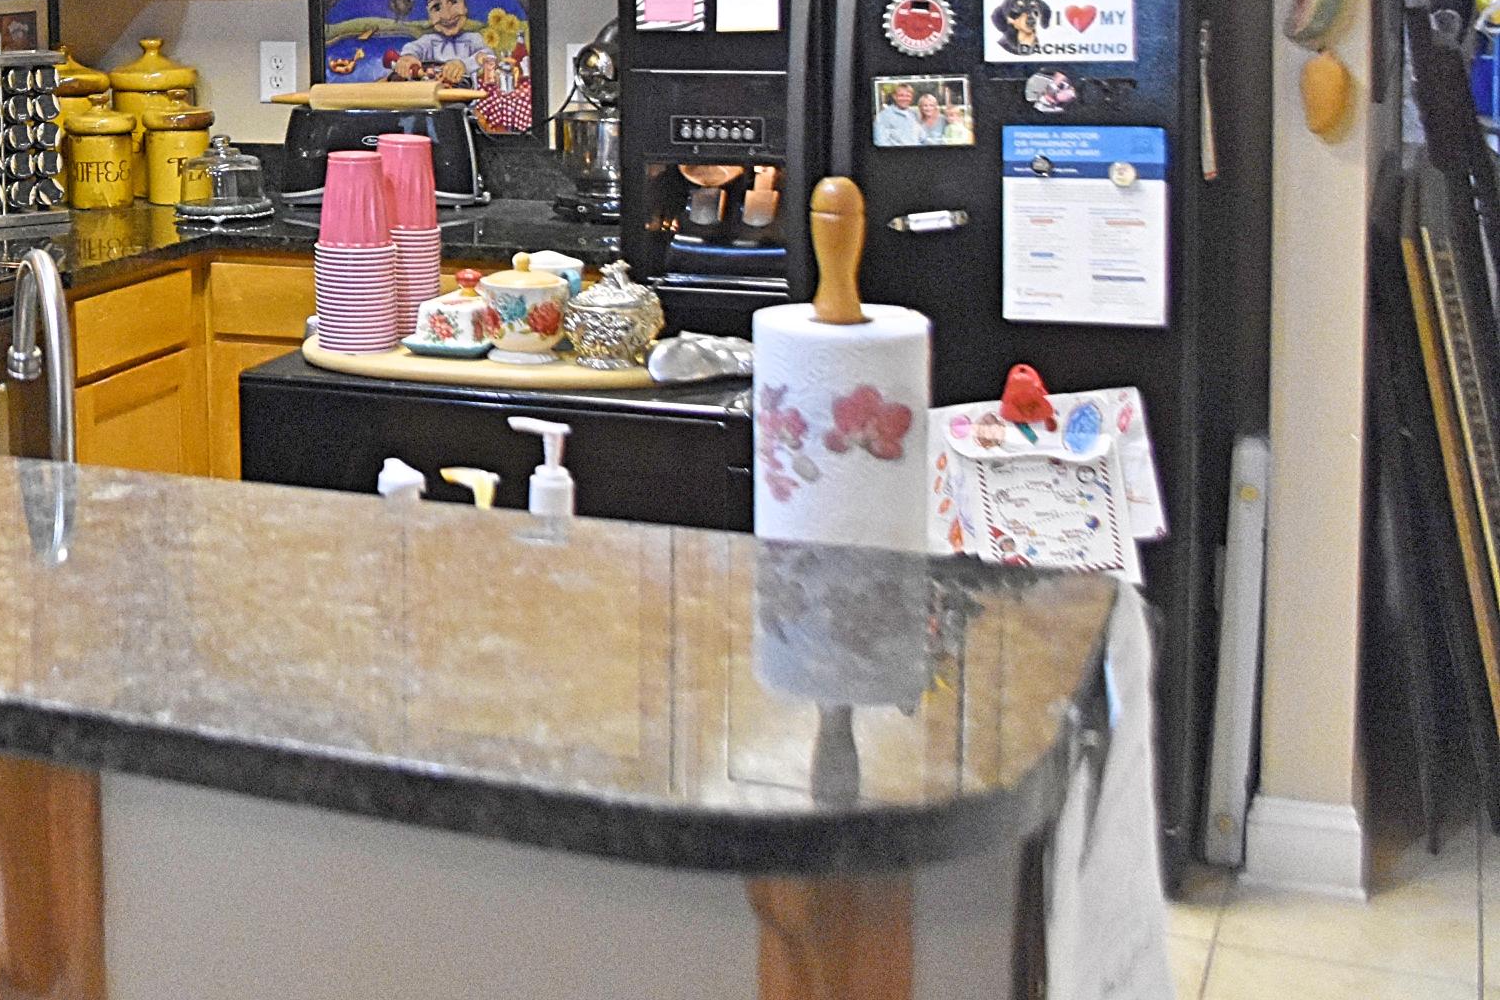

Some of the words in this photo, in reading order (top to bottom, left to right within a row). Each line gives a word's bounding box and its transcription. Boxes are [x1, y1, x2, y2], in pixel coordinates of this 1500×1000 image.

[1055, 12, 1061, 26] I
[1100, 11, 1126, 25] MY
[1019, 43, 1127, 55] DACHSHUND
[75, 159, 132, 183] OFFEE
